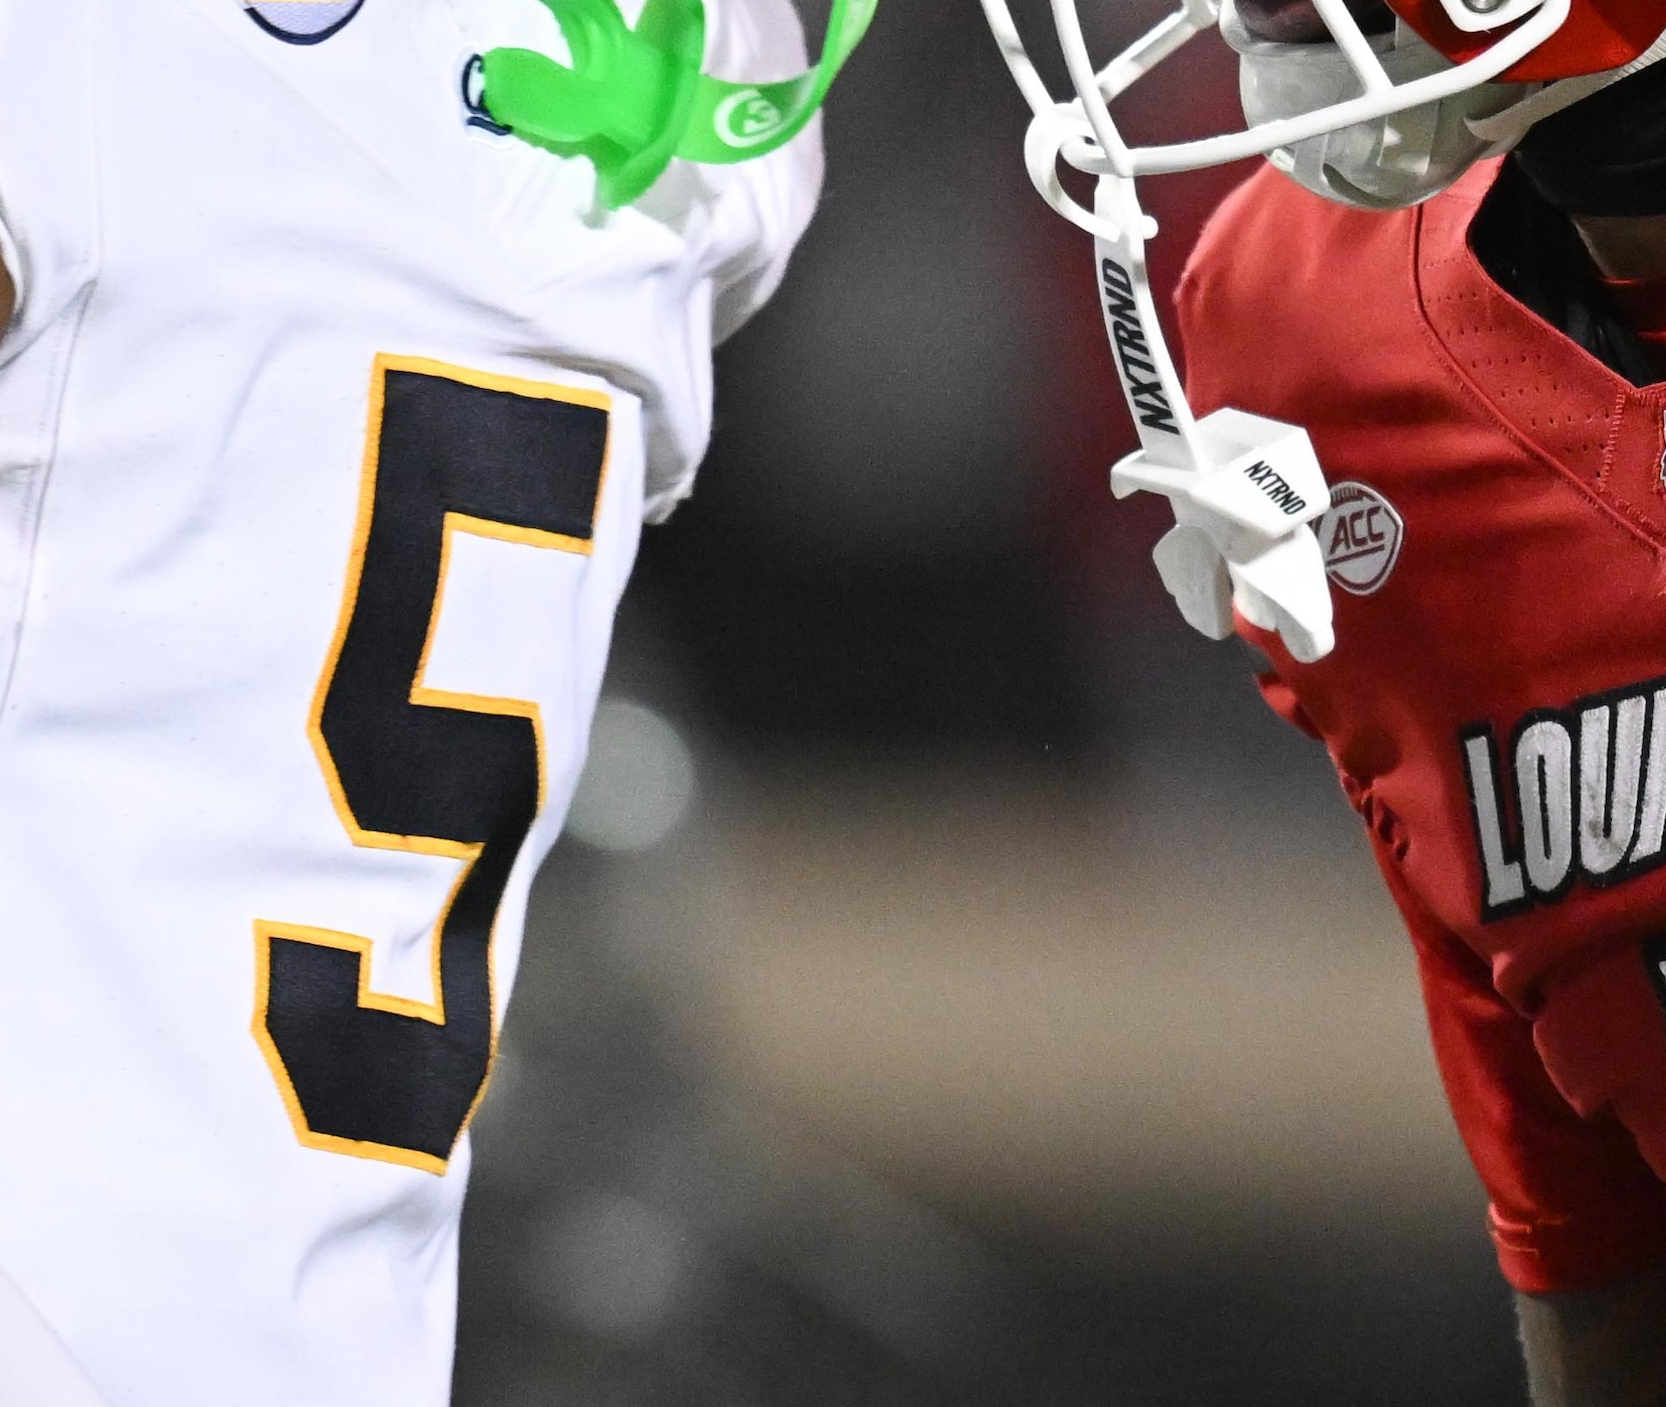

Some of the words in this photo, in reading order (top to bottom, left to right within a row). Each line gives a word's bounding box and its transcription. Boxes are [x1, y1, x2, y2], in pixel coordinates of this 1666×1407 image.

[1101, 257, 1181, 436] NXTRND
[1243, 460, 1306, 516] NXTRND
[1329, 505, 1385, 554] ACC
[250, 352, 612, 1176] 5
